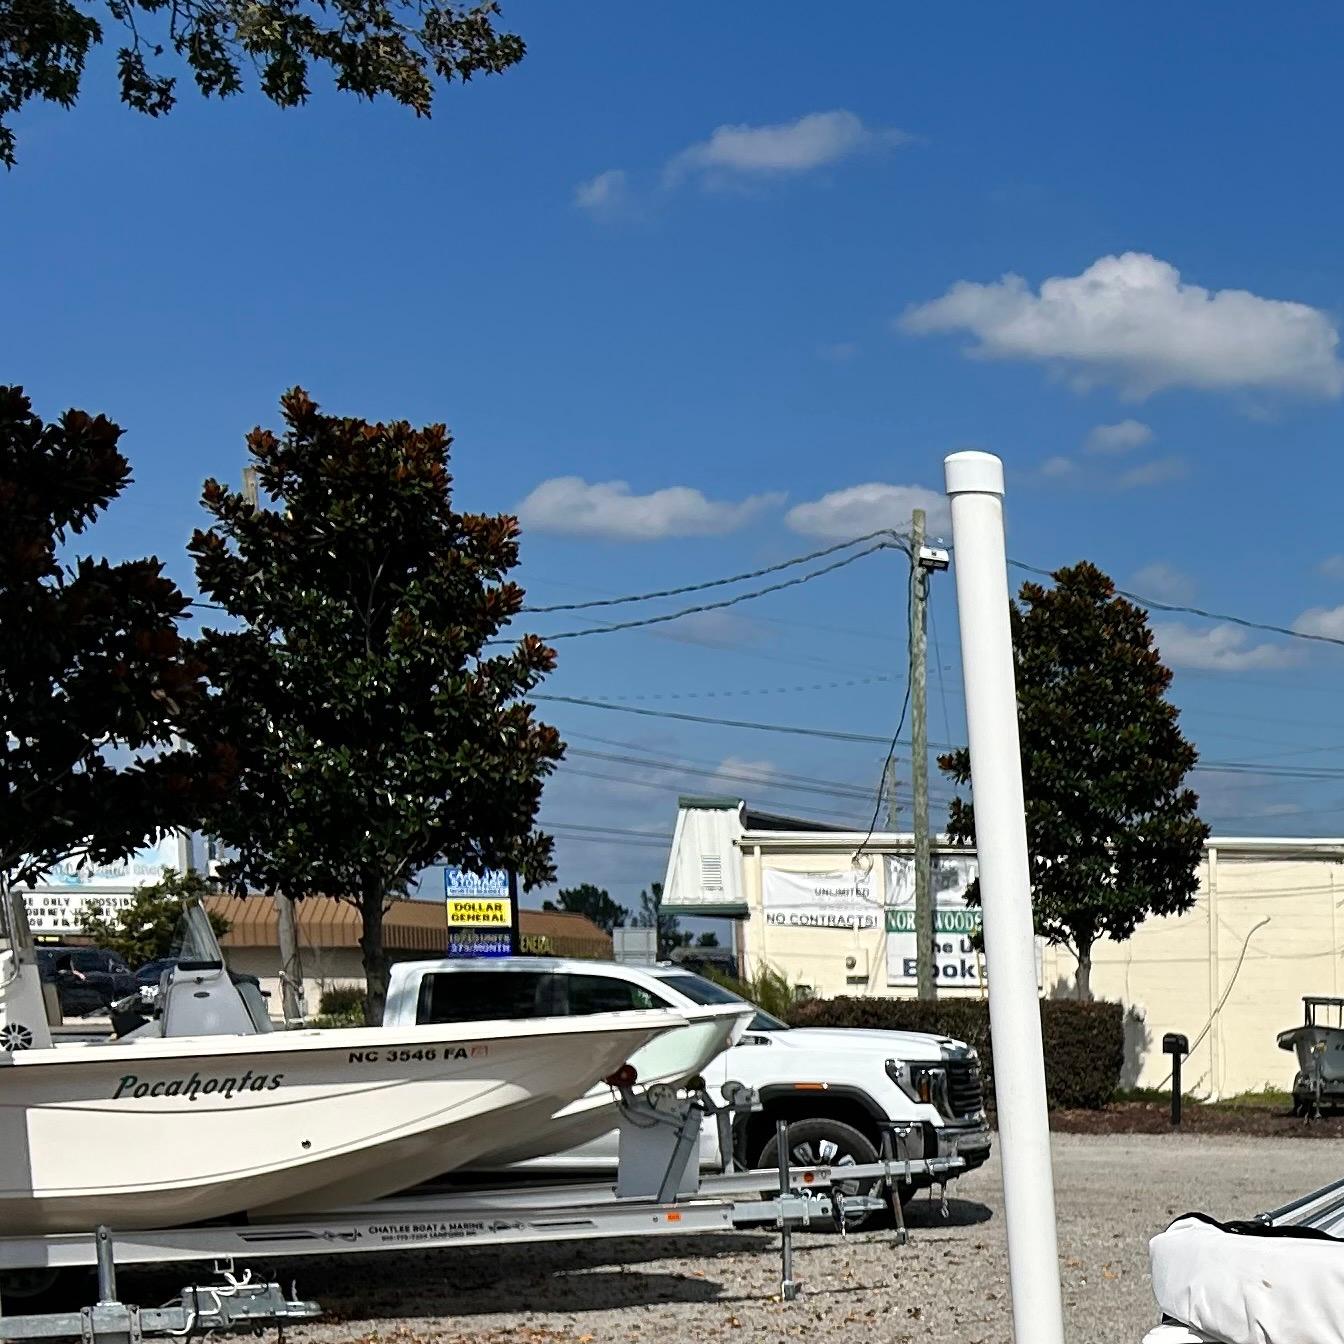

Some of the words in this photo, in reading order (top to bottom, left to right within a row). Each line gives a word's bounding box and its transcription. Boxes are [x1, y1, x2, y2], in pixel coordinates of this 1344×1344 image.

[43, 897, 70, 907] ONLY
[453, 902, 503, 911] DOLLAR
[451, 913, 506, 923] GENERAL
[767, 913, 786, 925] NO
[789, 913, 879, 928] CONTRACTS!
[348, 1050, 378, 1064] NC
[385, 1048, 437, 1062] 3546
[444, 1048, 469, 1060] FA
[112, 1070, 285, 1101] Pocahontas
[412, 1223, 438, 1233] BOAT
[449, 1221, 484, 1230] MARINE
